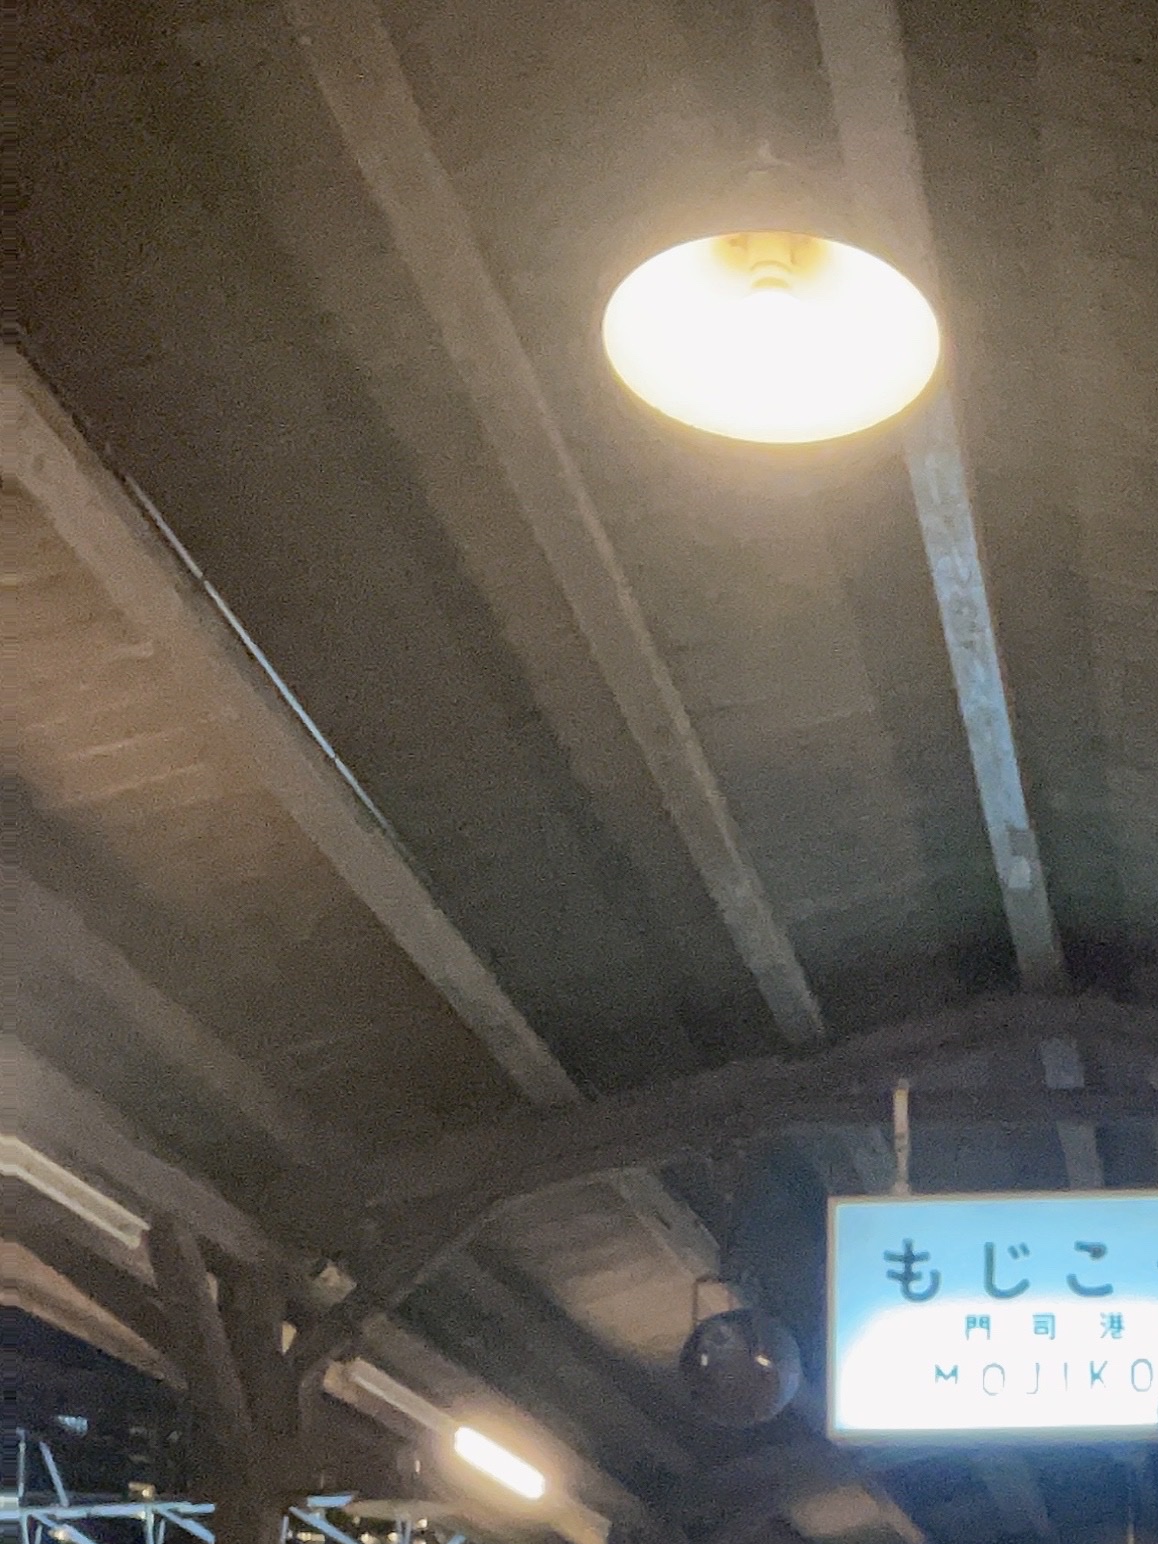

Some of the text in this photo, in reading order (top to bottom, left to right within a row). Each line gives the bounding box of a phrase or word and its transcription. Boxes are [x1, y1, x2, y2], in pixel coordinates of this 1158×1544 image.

[965, 1312, 1125, 1341] 門司港
[934, 1358, 1153, 1396] MOJIKO
